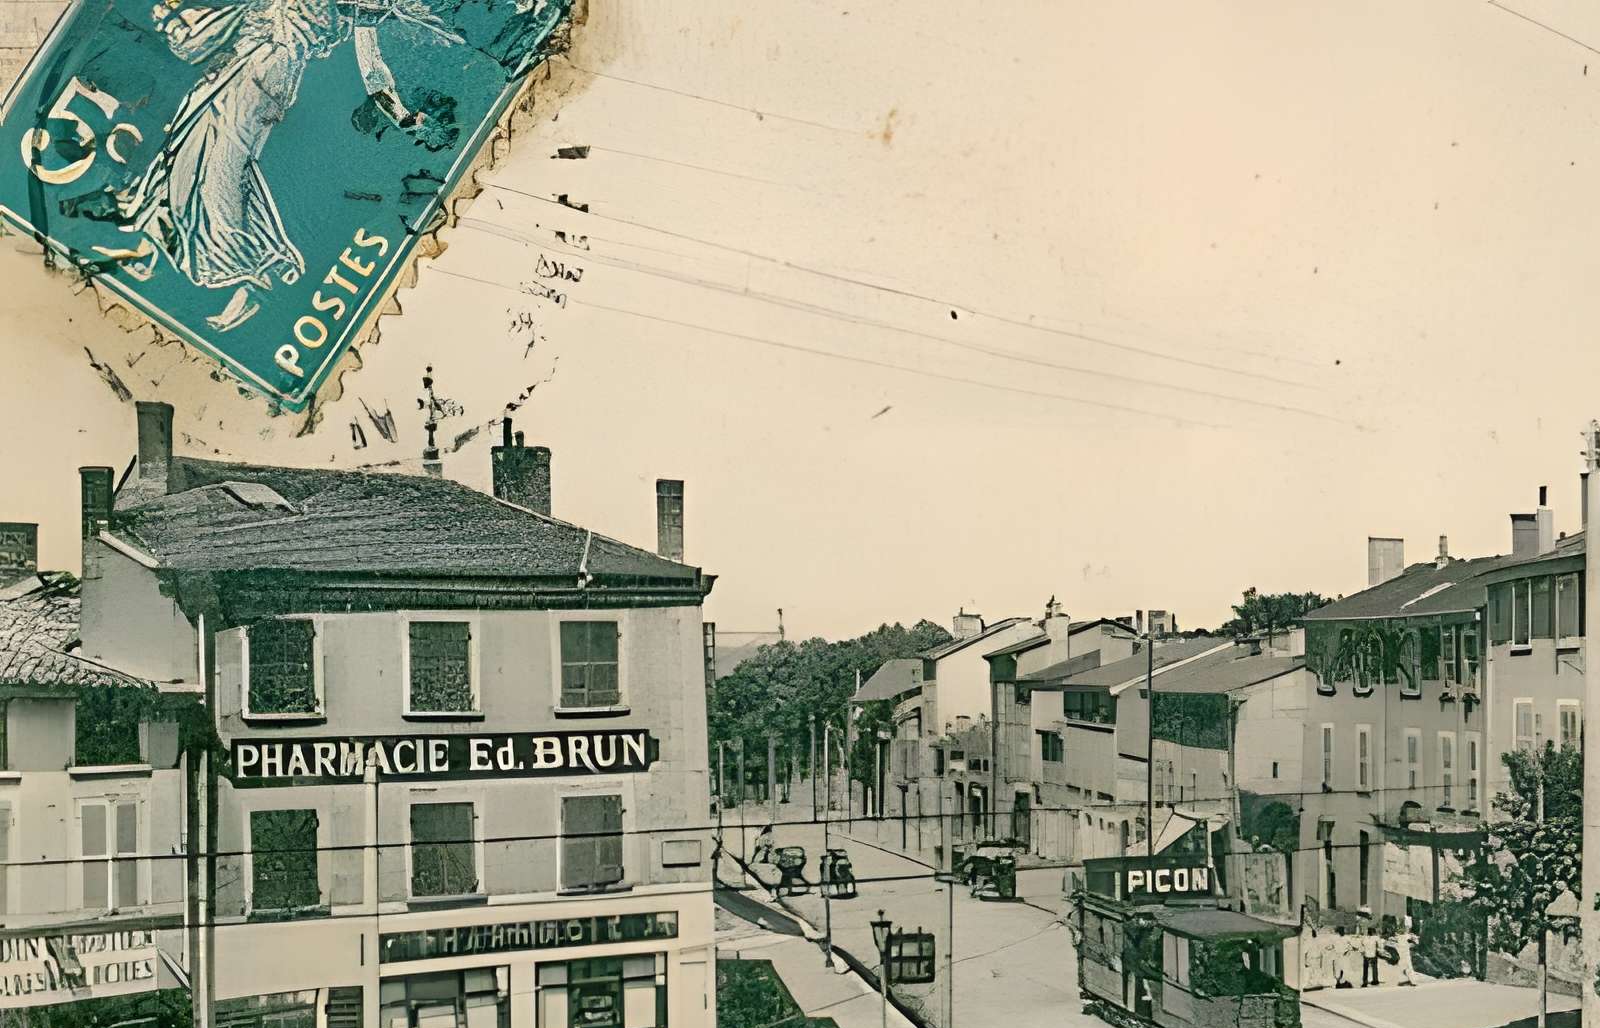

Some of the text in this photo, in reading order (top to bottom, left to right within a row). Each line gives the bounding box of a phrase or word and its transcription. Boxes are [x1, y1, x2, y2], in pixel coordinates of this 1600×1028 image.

[274, 227, 389, 378] POSTES
[237, 733, 647, 778] PHARMACIE Ed. BRUN
[1127, 867, 1209, 893] PICON
